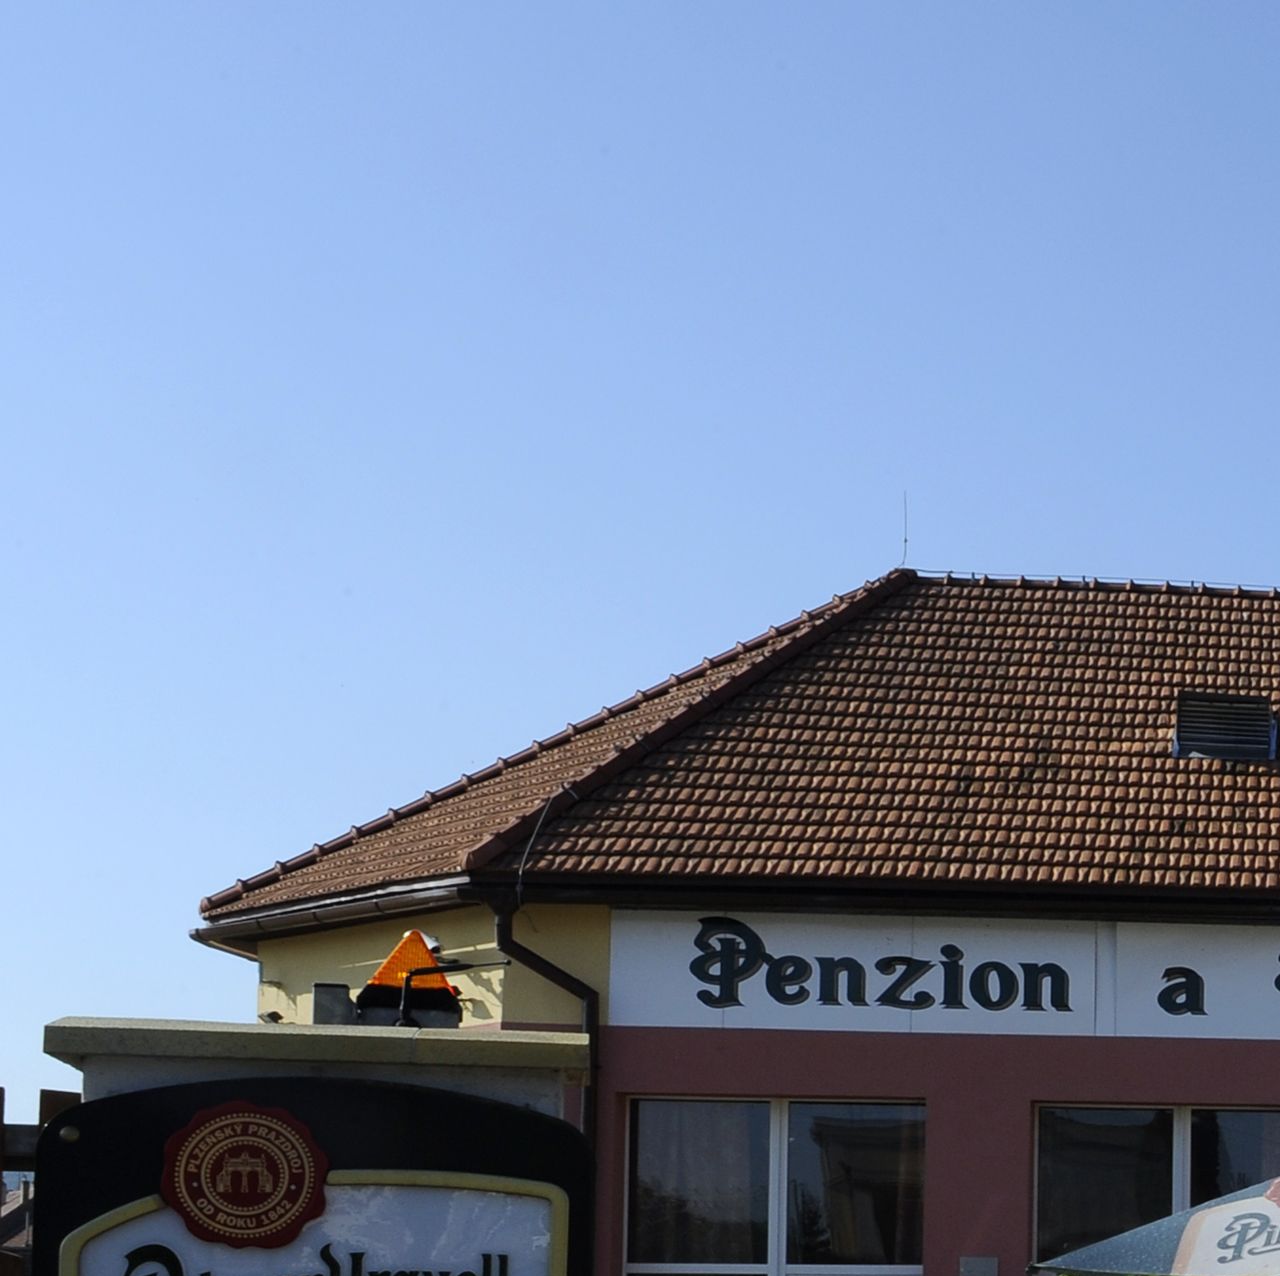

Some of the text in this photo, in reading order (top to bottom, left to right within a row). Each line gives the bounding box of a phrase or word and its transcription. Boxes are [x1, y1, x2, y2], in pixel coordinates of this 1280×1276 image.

[689, 916, 1073, 1012] Penzion
[1156, 967, 1209, 1016] a
[248, 1124, 303, 1174] PRAZDROJ
[196, 1198, 293, 1229] OD ROKU 1842
